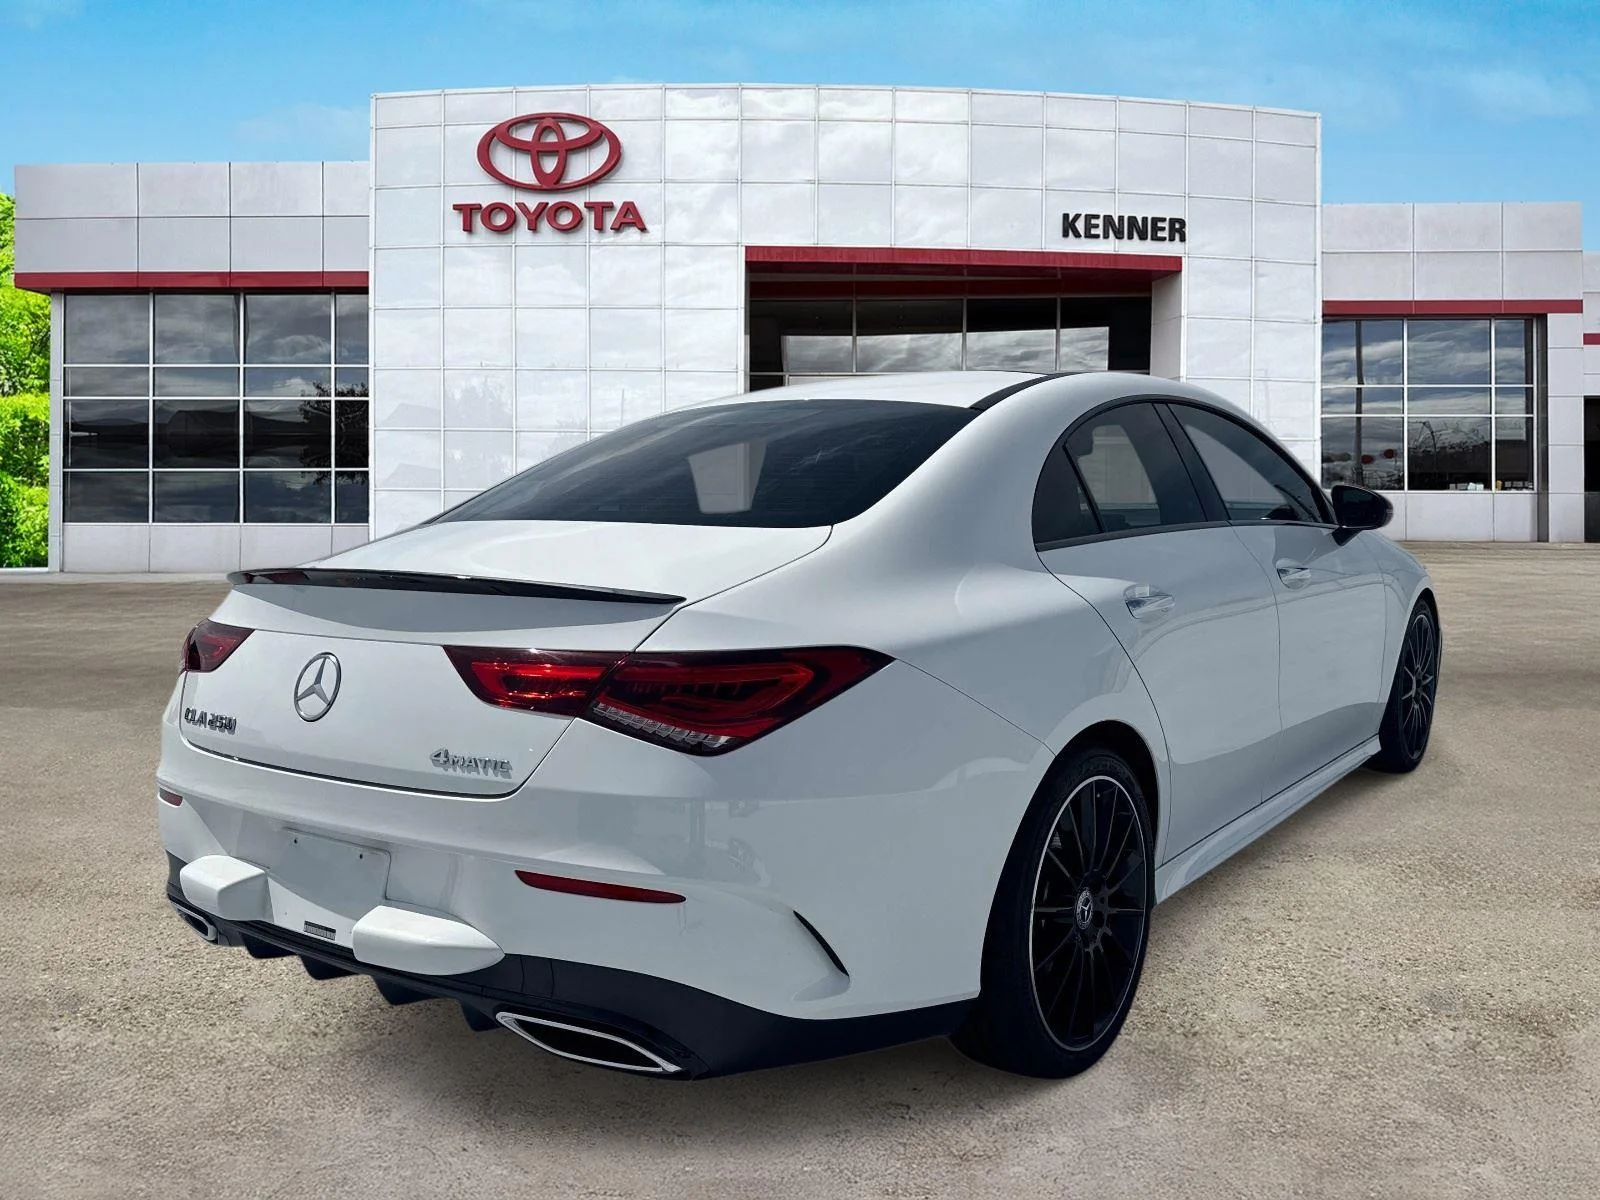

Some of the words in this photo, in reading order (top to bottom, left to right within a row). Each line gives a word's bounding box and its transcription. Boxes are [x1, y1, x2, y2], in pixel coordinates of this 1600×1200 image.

[453, 201, 647, 233] TOYOTA
[1062, 213, 1187, 242] KENNER
[184, 707, 208, 728] CLA
